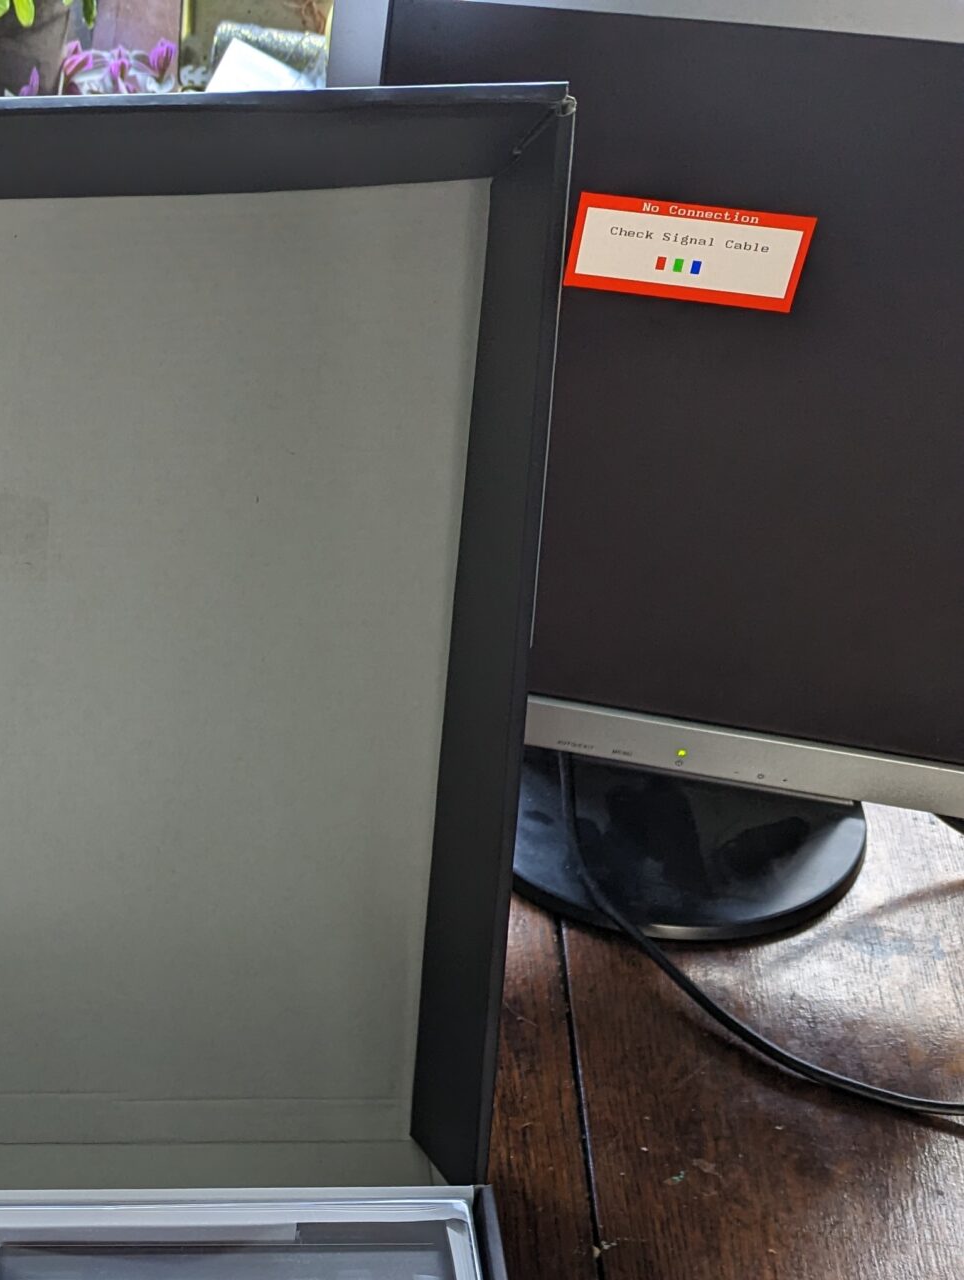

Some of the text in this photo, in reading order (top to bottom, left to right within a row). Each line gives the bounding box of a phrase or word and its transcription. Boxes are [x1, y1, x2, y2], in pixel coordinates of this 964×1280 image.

[642, 202, 760, 224] No Connection
[610, 226, 770, 253] Check Signal Cable
